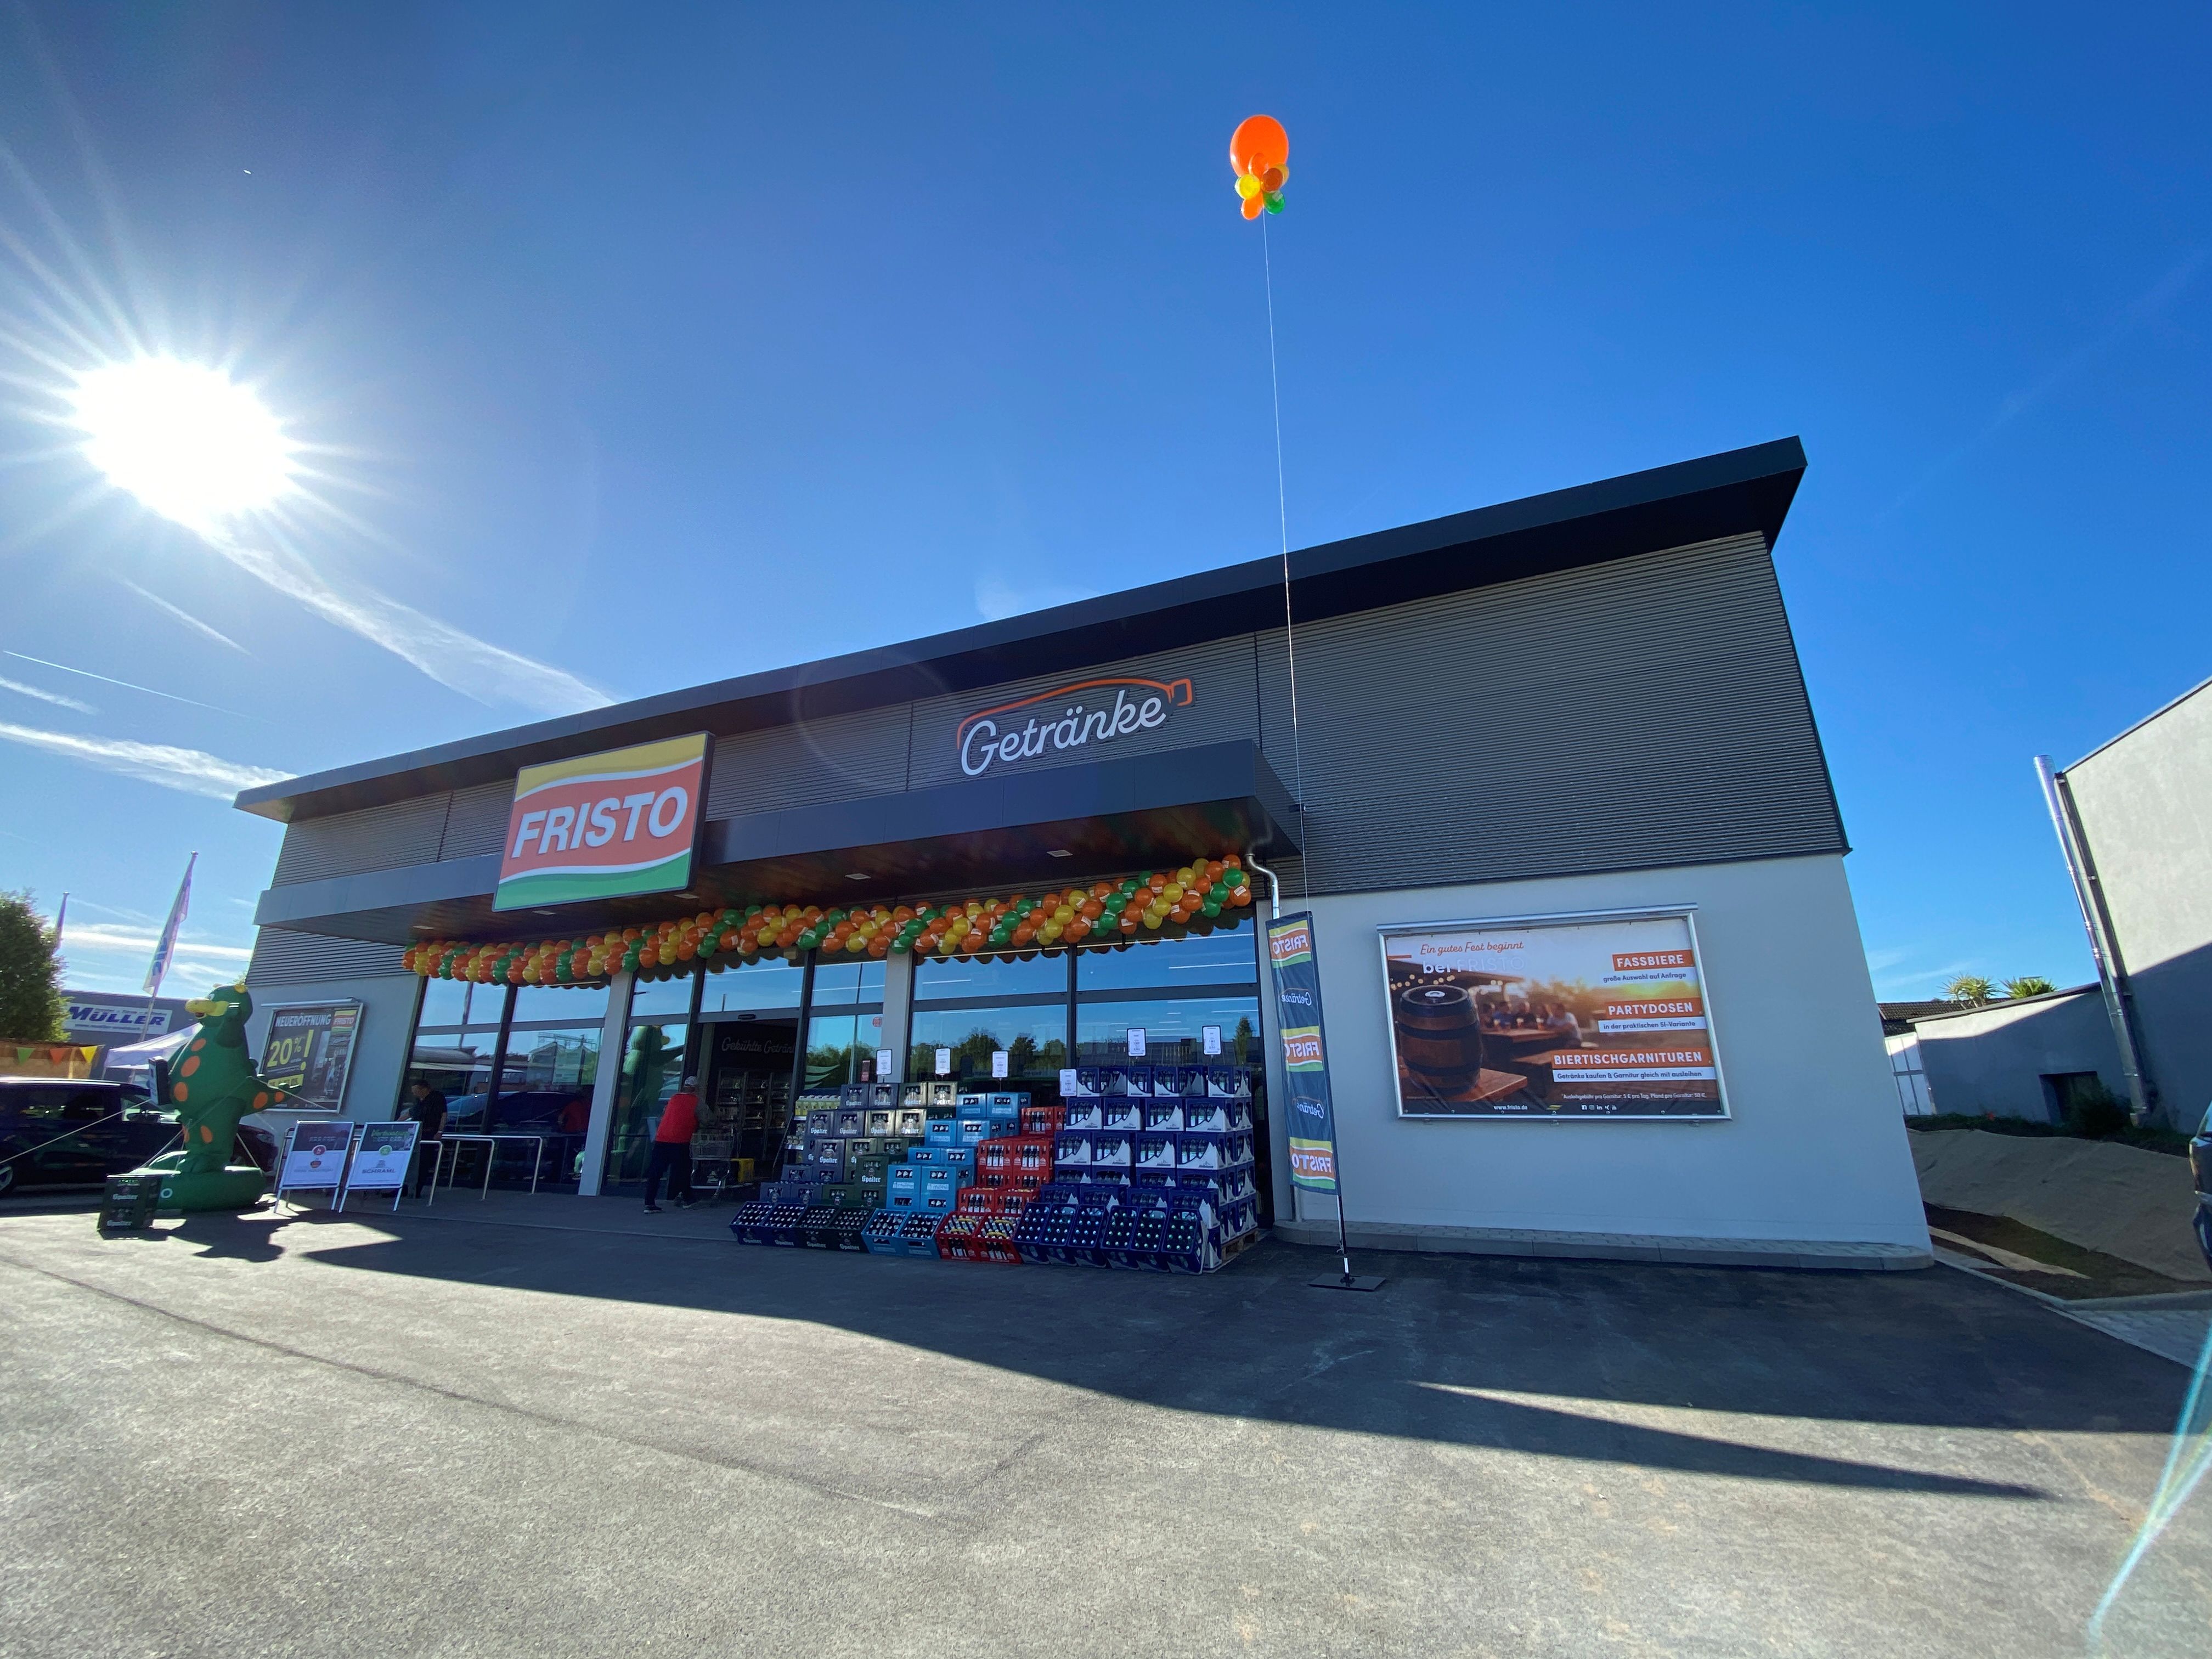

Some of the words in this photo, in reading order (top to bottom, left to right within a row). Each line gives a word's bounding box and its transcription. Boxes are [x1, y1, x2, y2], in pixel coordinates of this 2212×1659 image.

[961, 690, 1166, 775] Getränke
[511, 786, 688, 858] FRISTO
[1420, 944, 1436, 955] Ein
[1437, 945, 1463, 956] gutes
[1465, 942, 1484, 953] Fest
[1487, 941, 1523, 953] beginnt
[1423, 961, 1451, 974] bei
[1457, 957, 1524, 972] FRISTO
[1617, 955, 1684, 967] FASSBIERE
[69, 1006, 165, 1026] MÜLLER
[1608, 1002, 1692, 1015] PARTYDOSEN
[275, 1013, 331, 1027] NEUERÖFFNUNG
[1623, 1022, 1658, 1030] praktischen
[721, 1037, 763, 1052] Gekühlte
[1554, 1052, 1702, 1065] BIERTISCHGARNITUREN
